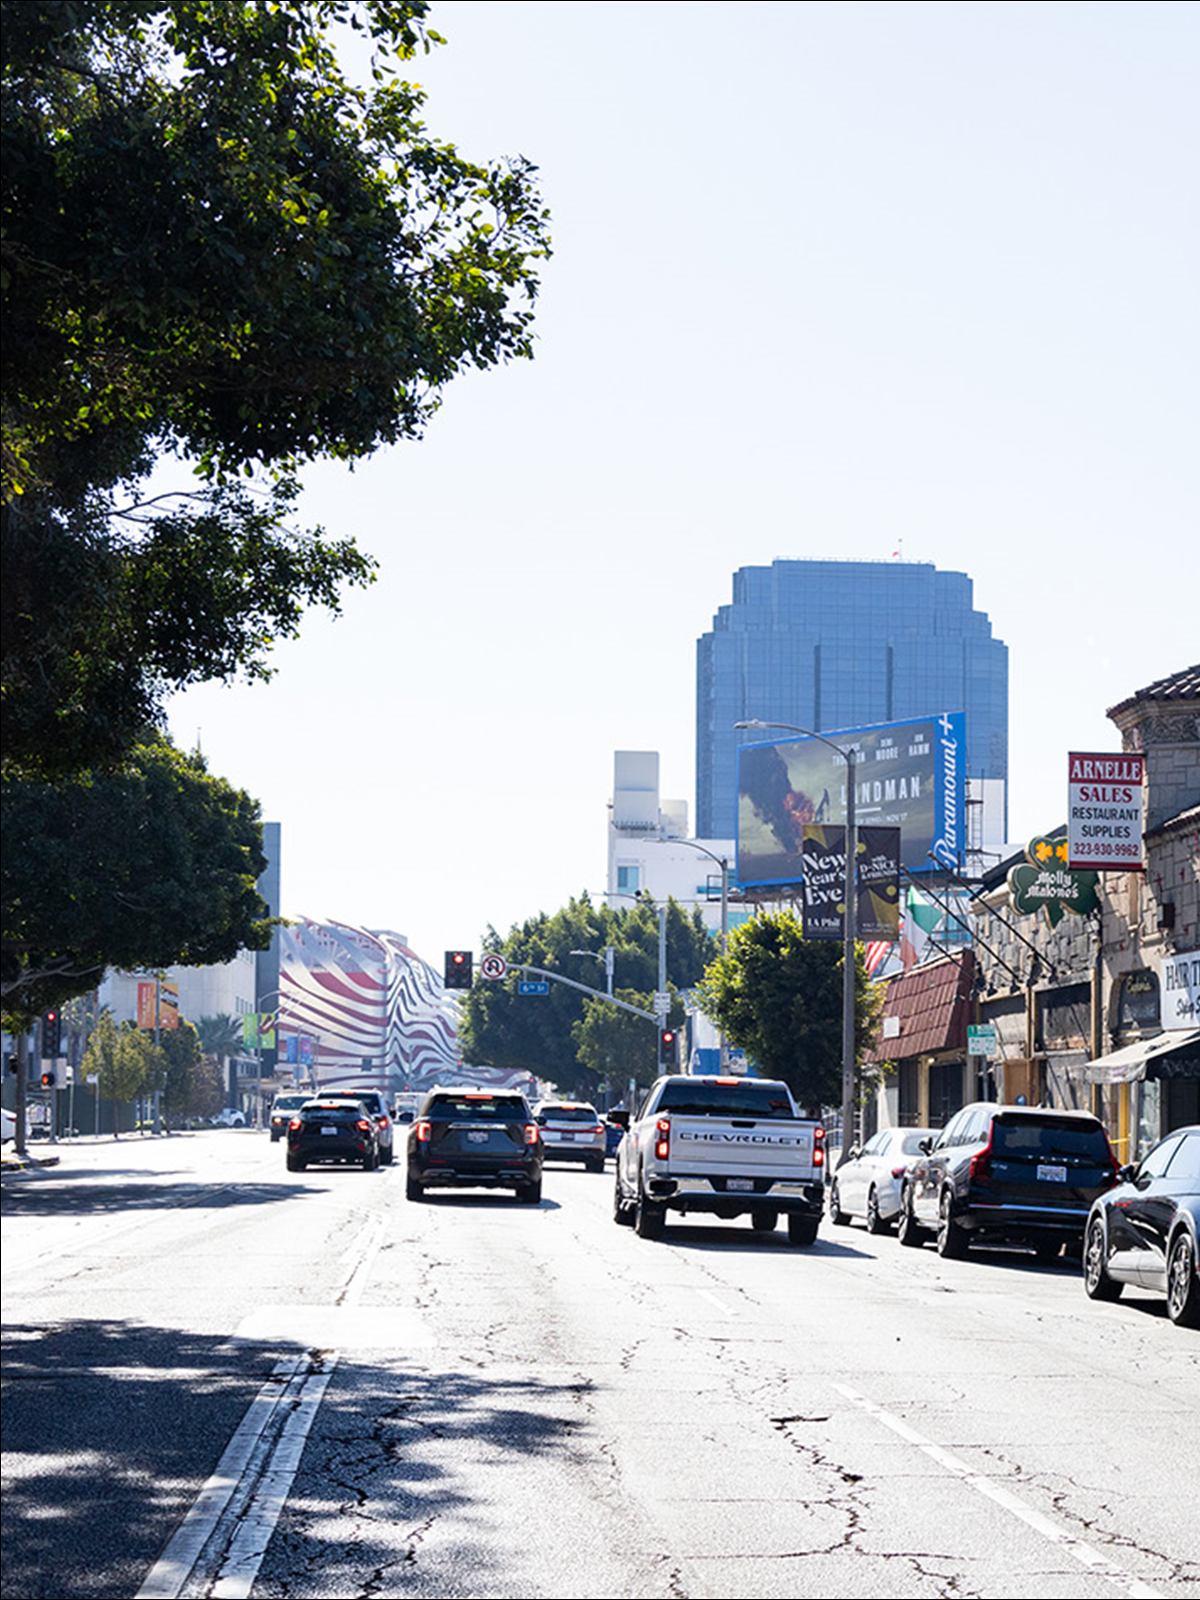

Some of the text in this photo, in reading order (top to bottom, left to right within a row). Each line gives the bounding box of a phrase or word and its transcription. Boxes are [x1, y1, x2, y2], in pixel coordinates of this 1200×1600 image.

[1071, 760, 1141, 780] ARNELLE
[1079, 786, 1133, 803] SALES
[1072, 806, 1139, 821] RESTAURANT
[1081, 824, 1131, 838] SUPPLIES
[1073, 842, 1139, 856] 323-930-9962
[802, 852, 847, 872] New
[1034, 870, 1072, 888] Molly
[805, 886, 843, 906] Eve
[1024, 882, 1079, 899] Malone's
[1165, 961, 1190, 991] HAIR
[680, 1132, 805, 1145] CHEVROLET
